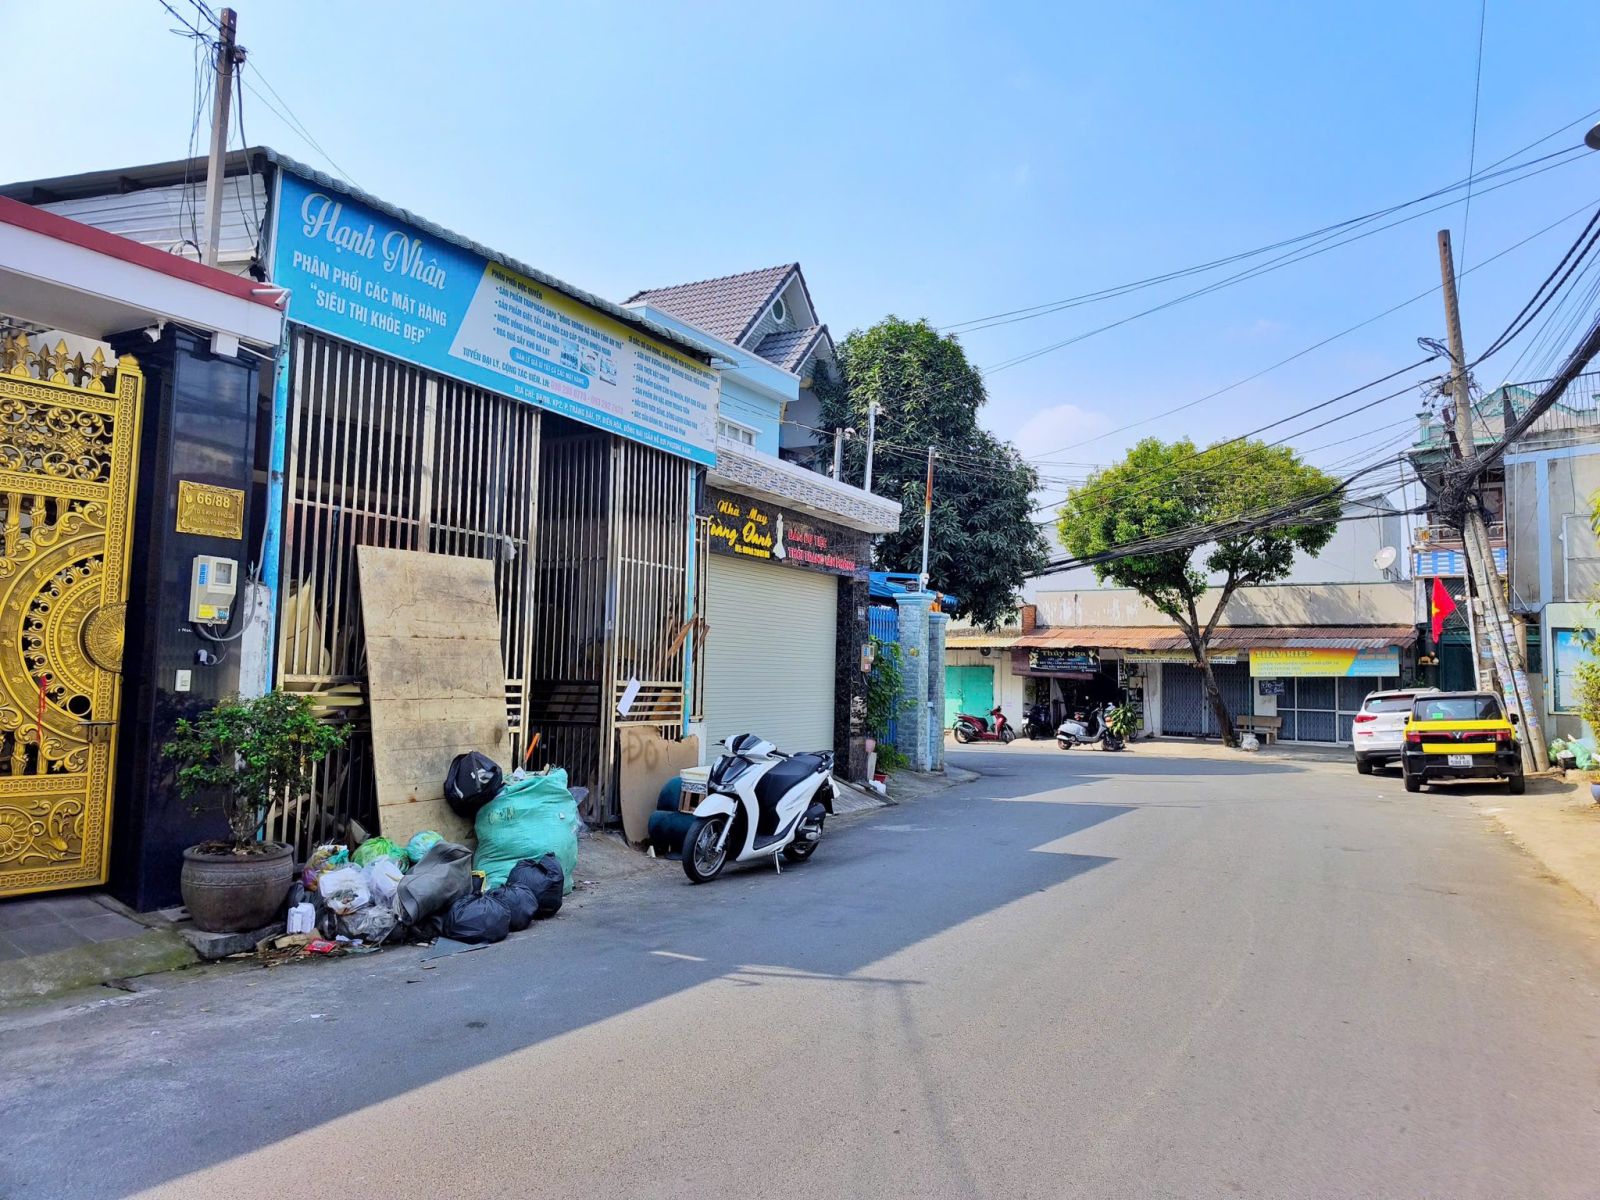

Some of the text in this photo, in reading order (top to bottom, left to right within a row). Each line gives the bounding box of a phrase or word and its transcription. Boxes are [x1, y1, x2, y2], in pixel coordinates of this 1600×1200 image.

[302, 193, 446, 290] Hạnh Nhân
[293, 250, 447, 327] PHÂN PHỐI CÁC MẶT HÀNG
[350, 302, 368, 327] THỊ
[371, 310, 400, 335] KHỎE
[197, 493, 230, 508] 66/88
[717, 500, 768, 526] Nhà May
